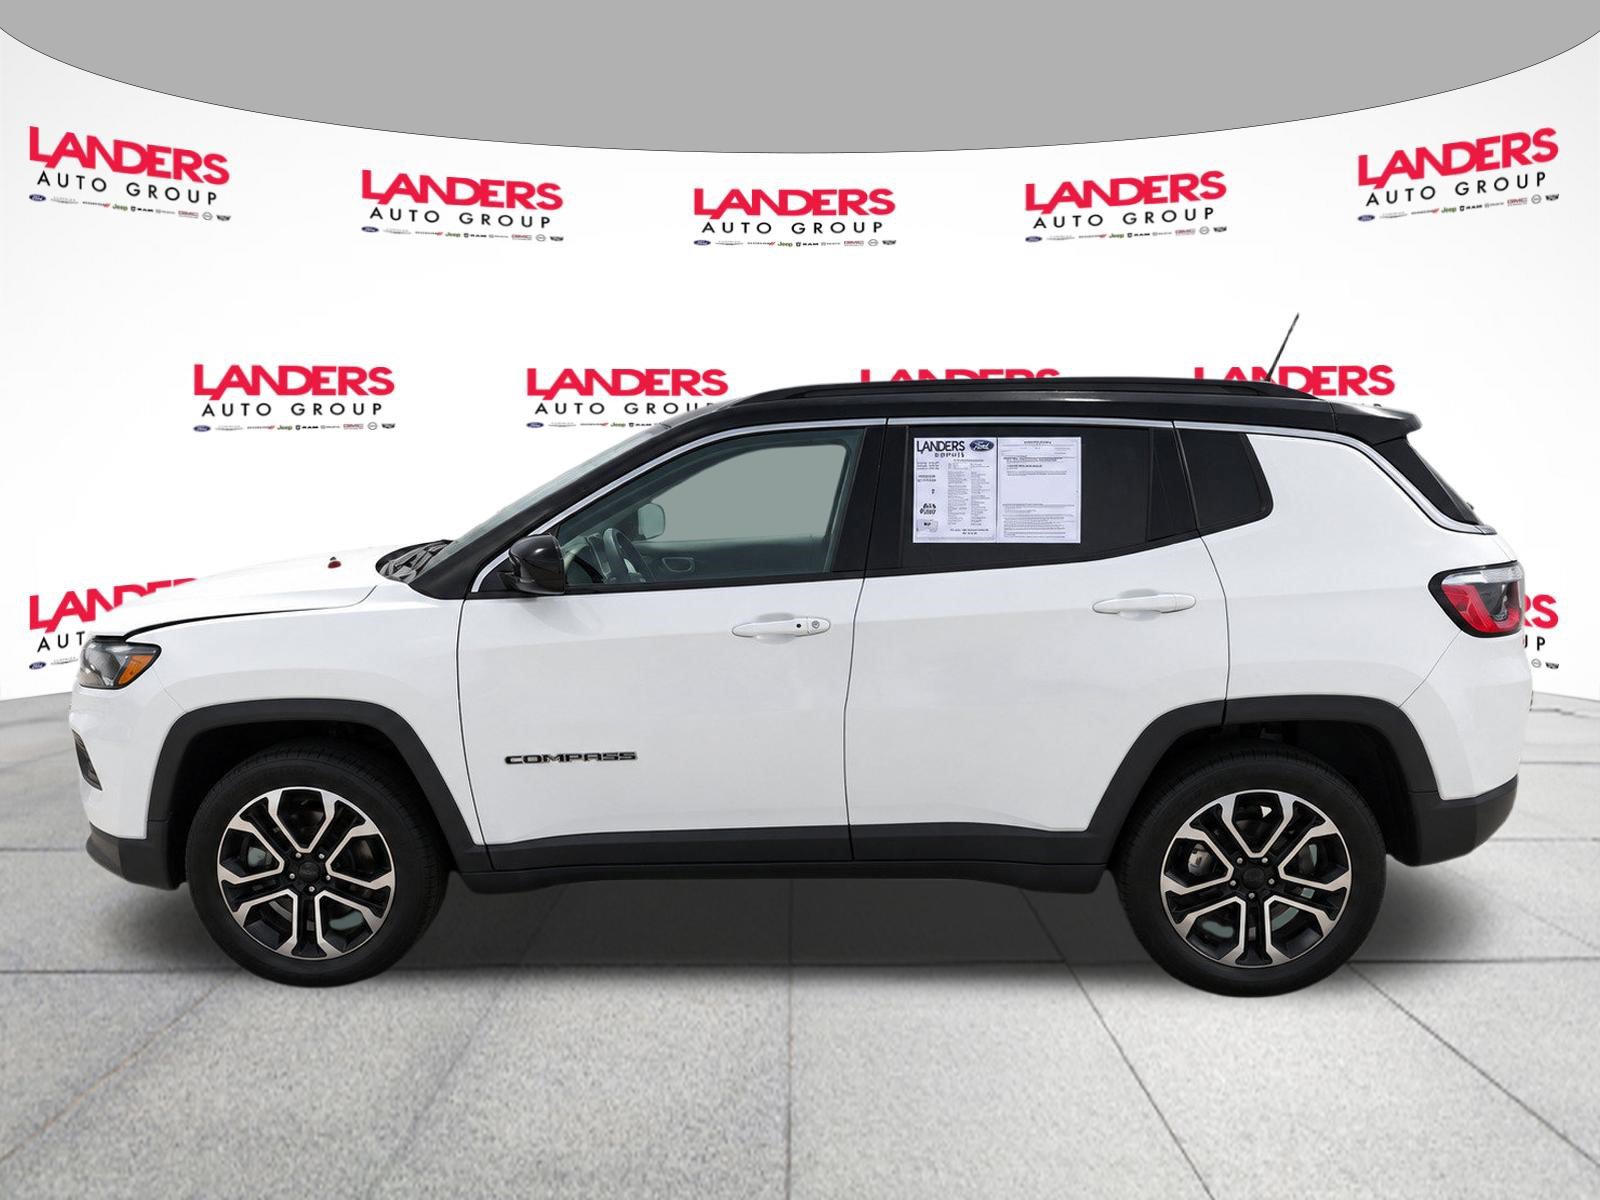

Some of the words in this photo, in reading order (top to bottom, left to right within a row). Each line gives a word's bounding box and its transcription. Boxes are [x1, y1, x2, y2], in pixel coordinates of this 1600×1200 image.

[29, 127, 230, 185] LANDERS
[1358, 127, 1559, 190] LANDERS
[37, 170, 107, 193] AUTO
[126, 182, 217, 205] GROUP
[362, 169, 563, 211] LANDERS
[1025, 170, 1227, 215] LANDERS
[1366, 185, 1436, 207] AUTO
[1454, 171, 1546, 196] GROUP
[369, 206, 440, 223] AUTO
[459, 212, 550, 229] GROUP
[694, 188, 896, 220] LANDERS
[1033, 214, 1104, 229] AUTO
[1122, 207, 1214, 225] GROUP
[701, 222, 772, 234] AUTO
[791, 221, 883, 234] GROUP
[194, 364, 395, 401] LANDERS
[527, 367, 729, 401] LANDERS
[201, 402, 272, 417] AUTO
[290, 402, 382, 416] GROUP
[535, 402, 605, 415] AUTO
[624, 402, 714, 415] GROU
[916, 440, 966, 454] LANDERS
[37, 631, 85, 653] AUT
[504, 751, 638, 765] COMPASS
